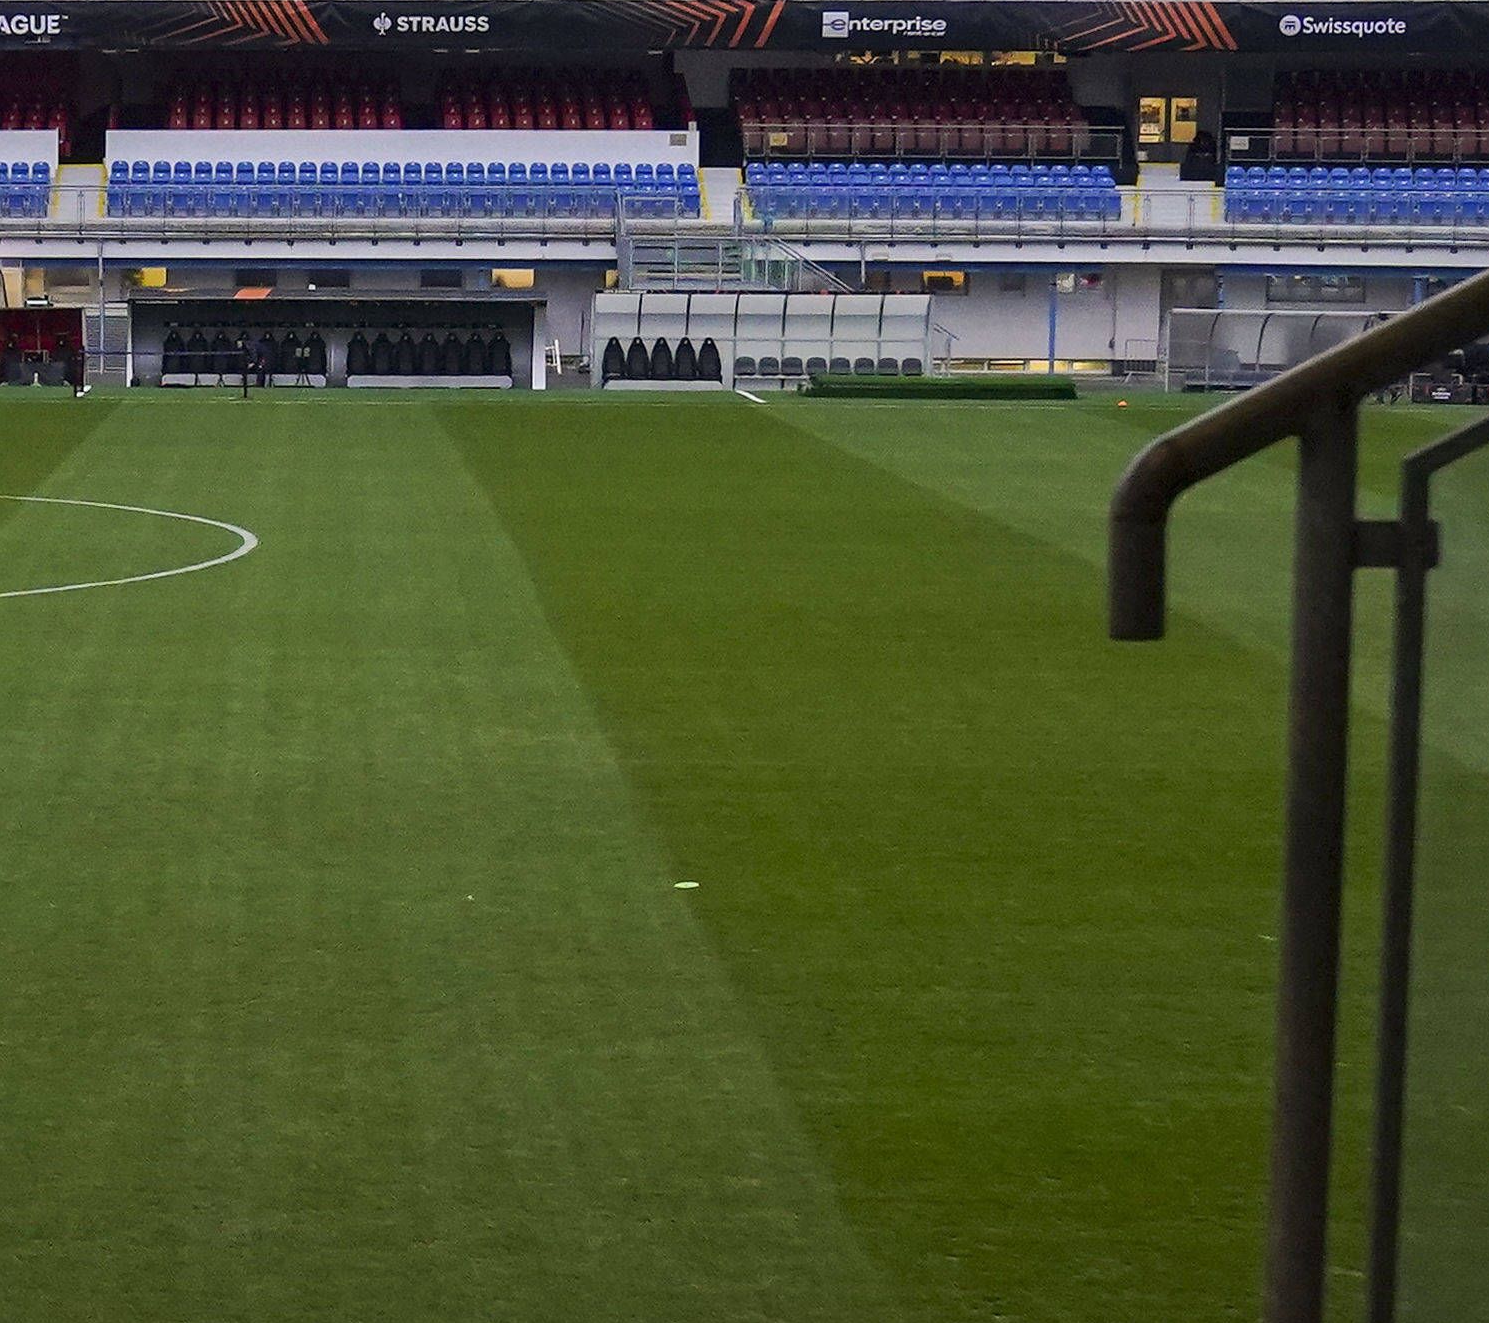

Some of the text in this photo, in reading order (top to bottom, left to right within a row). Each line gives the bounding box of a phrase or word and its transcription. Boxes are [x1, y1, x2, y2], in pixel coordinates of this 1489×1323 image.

[396, 16, 490, 32] STRAUSS
[829, 16, 947, 35] enterprise
[1302, 17, 1406, 38] Swissquote
